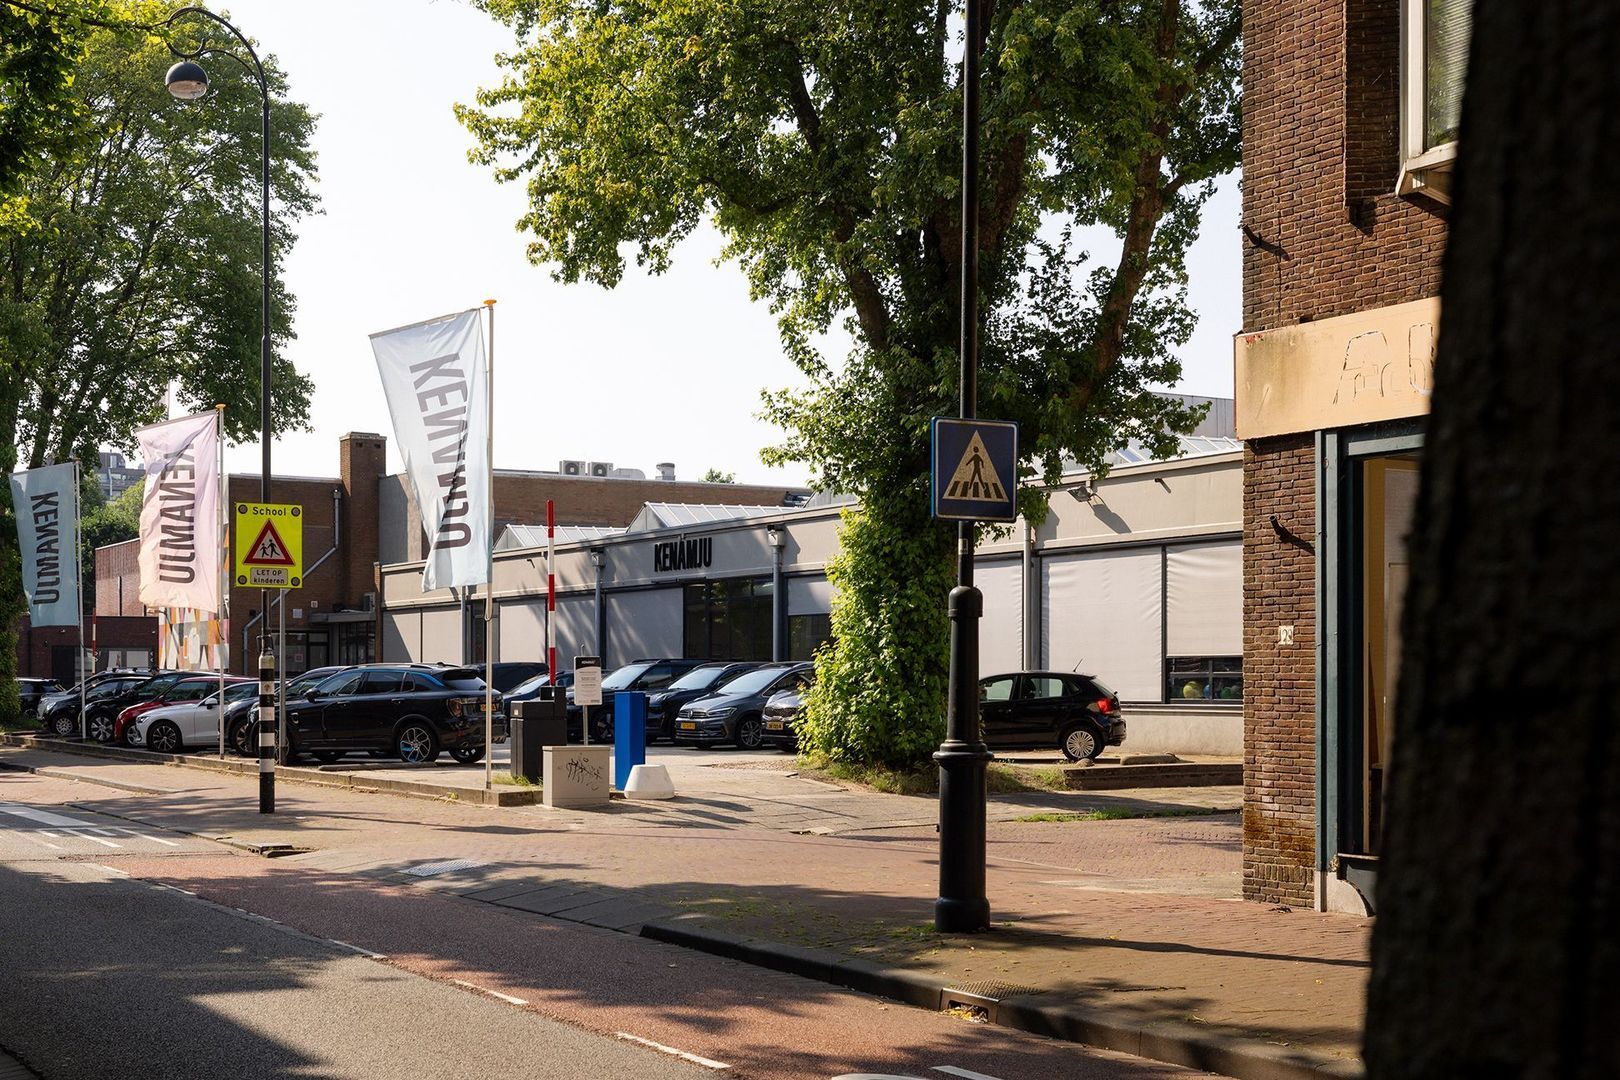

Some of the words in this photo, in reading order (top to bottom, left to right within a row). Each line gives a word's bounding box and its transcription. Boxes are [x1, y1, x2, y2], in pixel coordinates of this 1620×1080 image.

[252, 507, 286, 515] School
[655, 537, 711, 572] KENAMJU
[256, 569, 271, 577] LET
[272, 570, 283, 578] OP
[253, 578, 285, 586] kinderen
